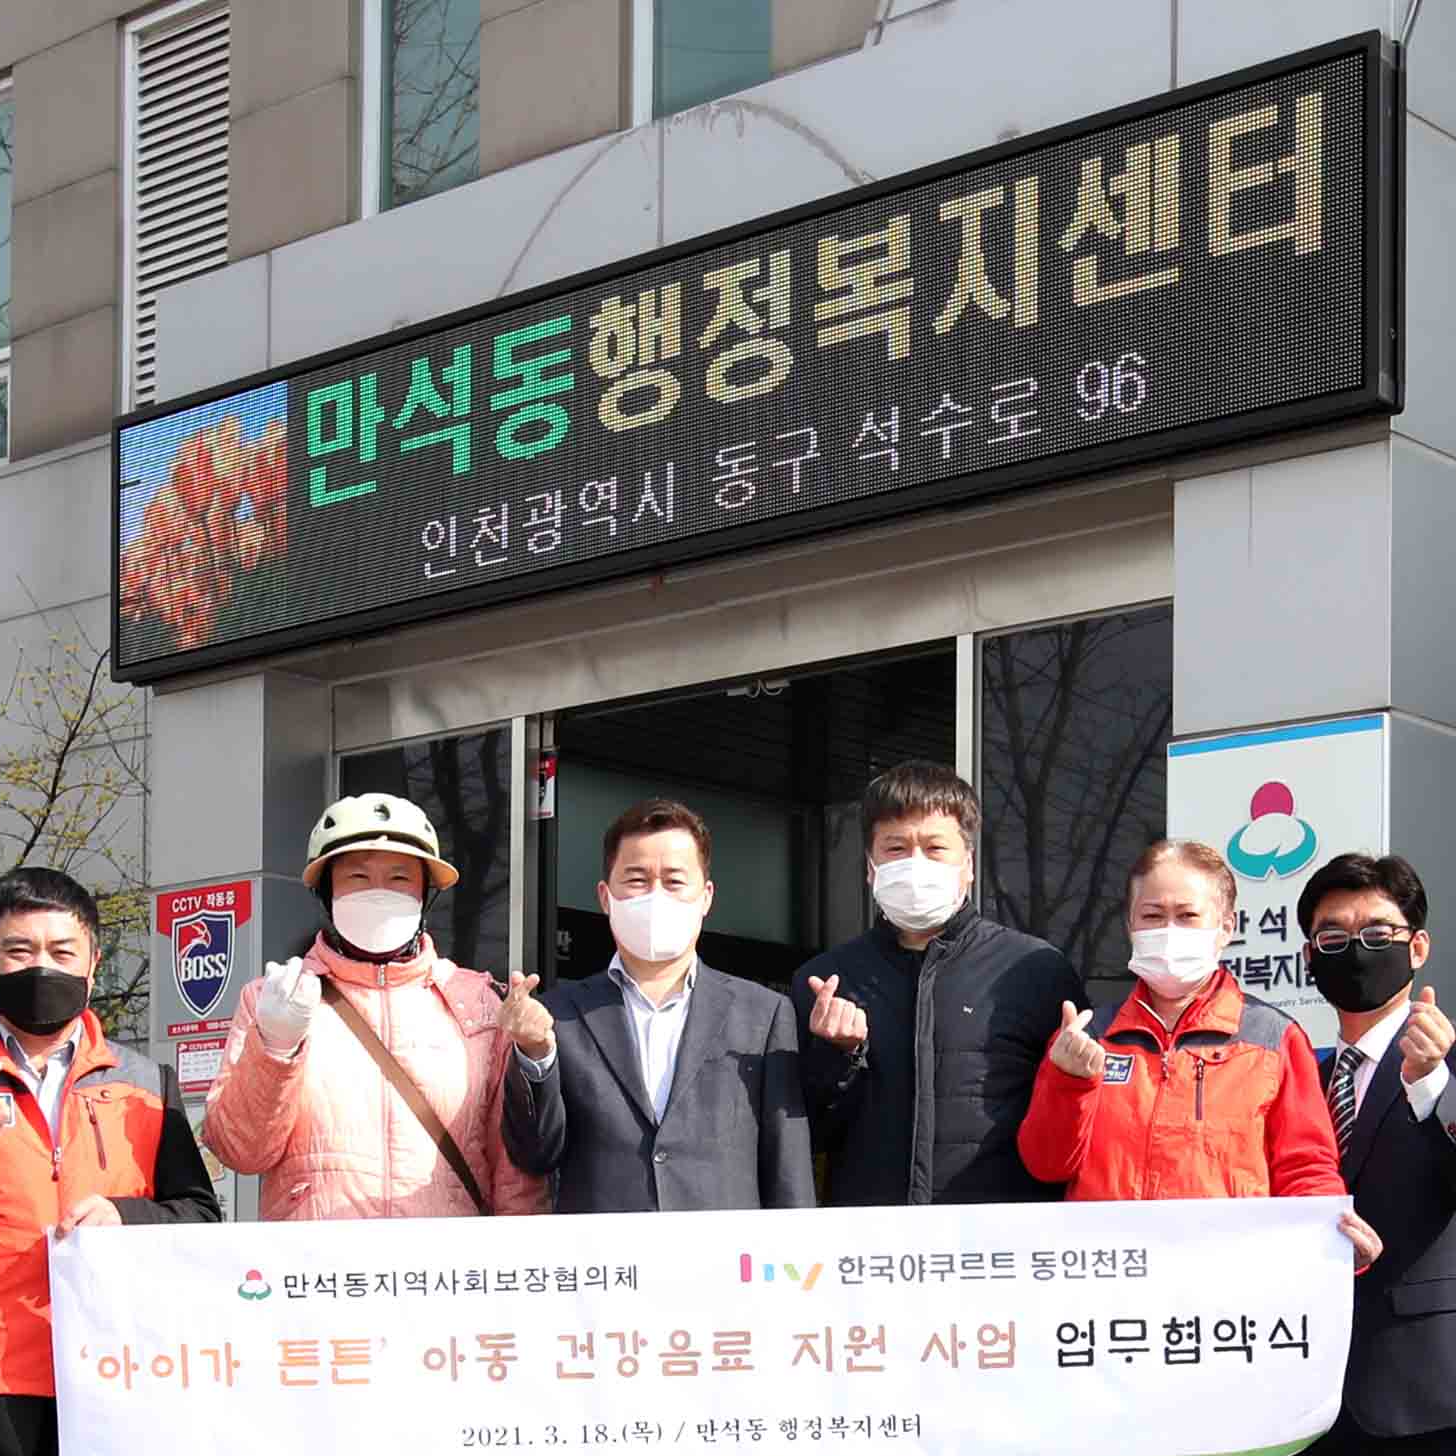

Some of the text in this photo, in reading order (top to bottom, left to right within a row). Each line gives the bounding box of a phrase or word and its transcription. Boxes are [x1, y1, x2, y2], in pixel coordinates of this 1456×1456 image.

[421, 351, 1147, 578] 인천광역시 동구 석수로 96
[172, 895, 203, 913] CCTV
[180, 952, 227, 982] BOSS
[282, 1264, 639, 1299] 만석동지역사회보장협의체
[837, 1247, 1148, 1284] 한국야쿠르트 동인천점
[422, 1331, 520, 1383] 아동
[556, 1328, 756, 1381] 건강음료
[790, 1323, 887, 1374] 지원
[919, 1320, 1017, 1371] 사업
[1055, 1313, 1310, 1368] 업무협약식
[461, 1427, 535, 1448] 2021.
[544, 1425, 567, 1446] 3.
[580, 1418, 663, 1446] 18.(목)
[695, 1417, 769, 1443] 만석동
[777, 1412, 922, 1442] 행정복지센터
